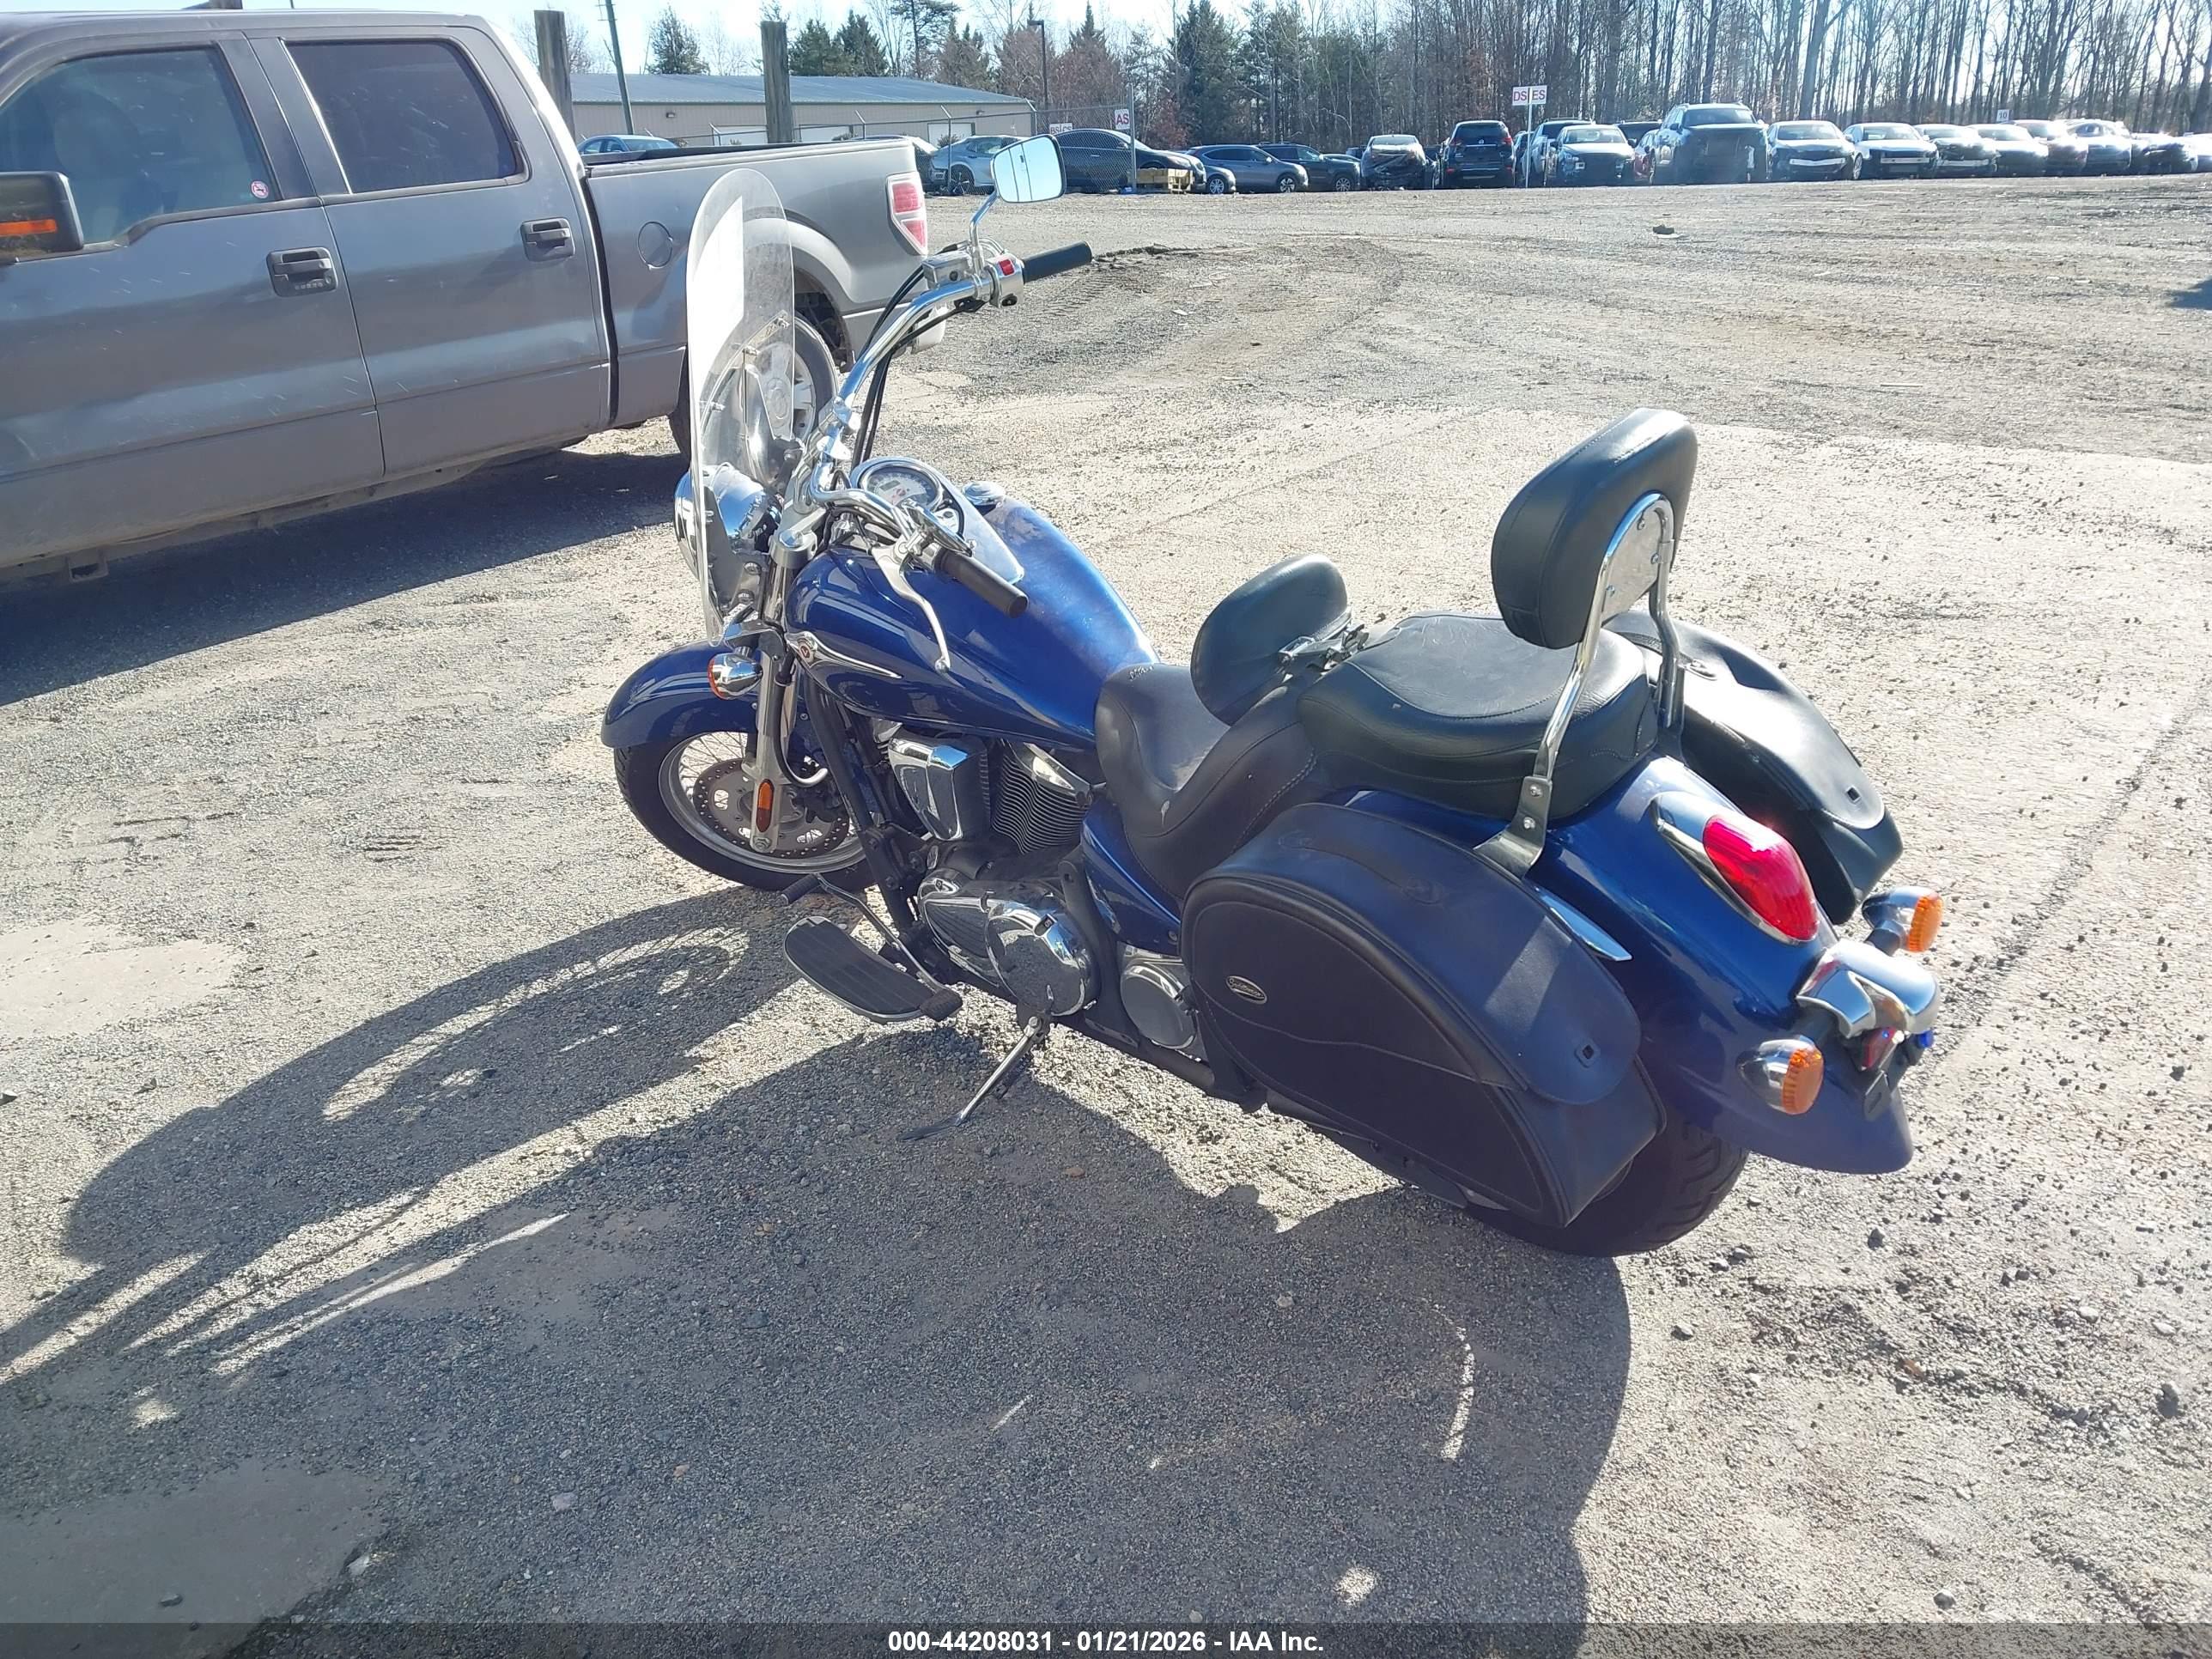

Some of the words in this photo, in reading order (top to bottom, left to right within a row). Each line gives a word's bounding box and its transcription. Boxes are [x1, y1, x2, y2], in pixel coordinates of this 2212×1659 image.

[1513, 91, 1527, 101] DS
[1532, 90, 1546, 100] ES
[1115, 113, 1129, 125] AS
